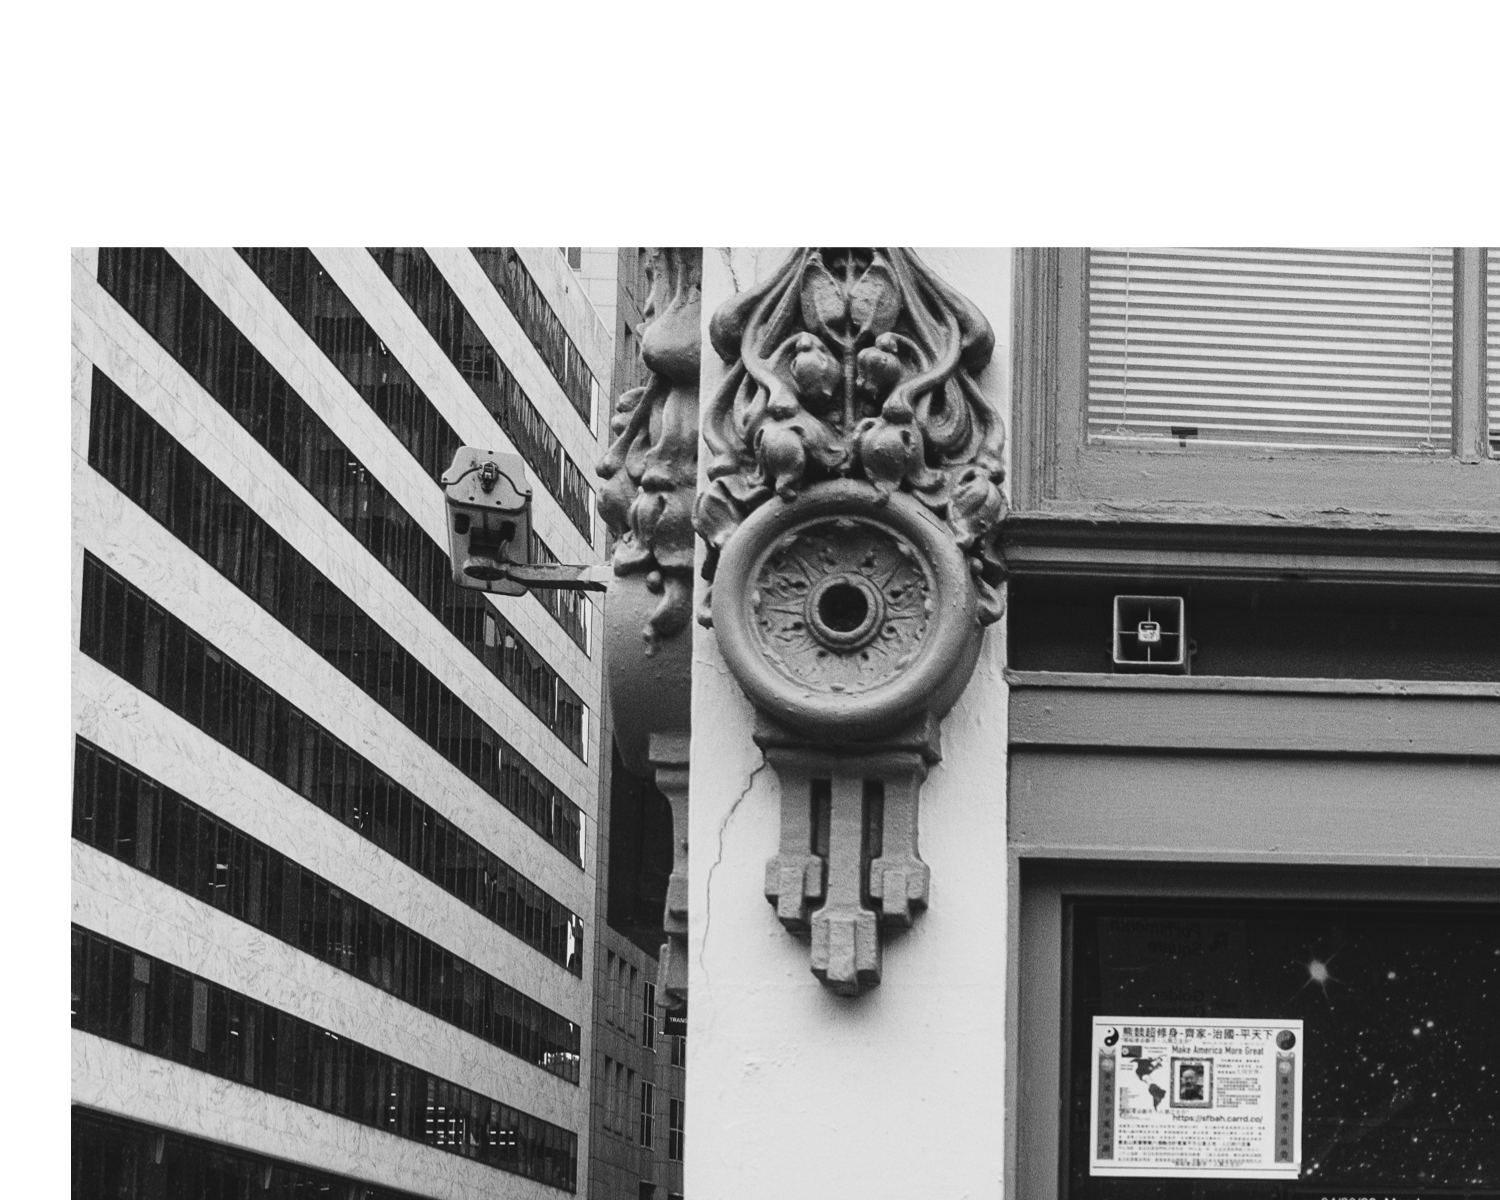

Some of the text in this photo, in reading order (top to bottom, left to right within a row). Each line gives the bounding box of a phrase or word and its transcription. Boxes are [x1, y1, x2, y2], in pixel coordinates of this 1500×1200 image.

[1172, 1045, 1191, 1055] Make
[1193, 1045, 1223, 1055] America
[1225, 1046, 1243, 1056] More
[1245, 1046, 1264, 1056] Great
